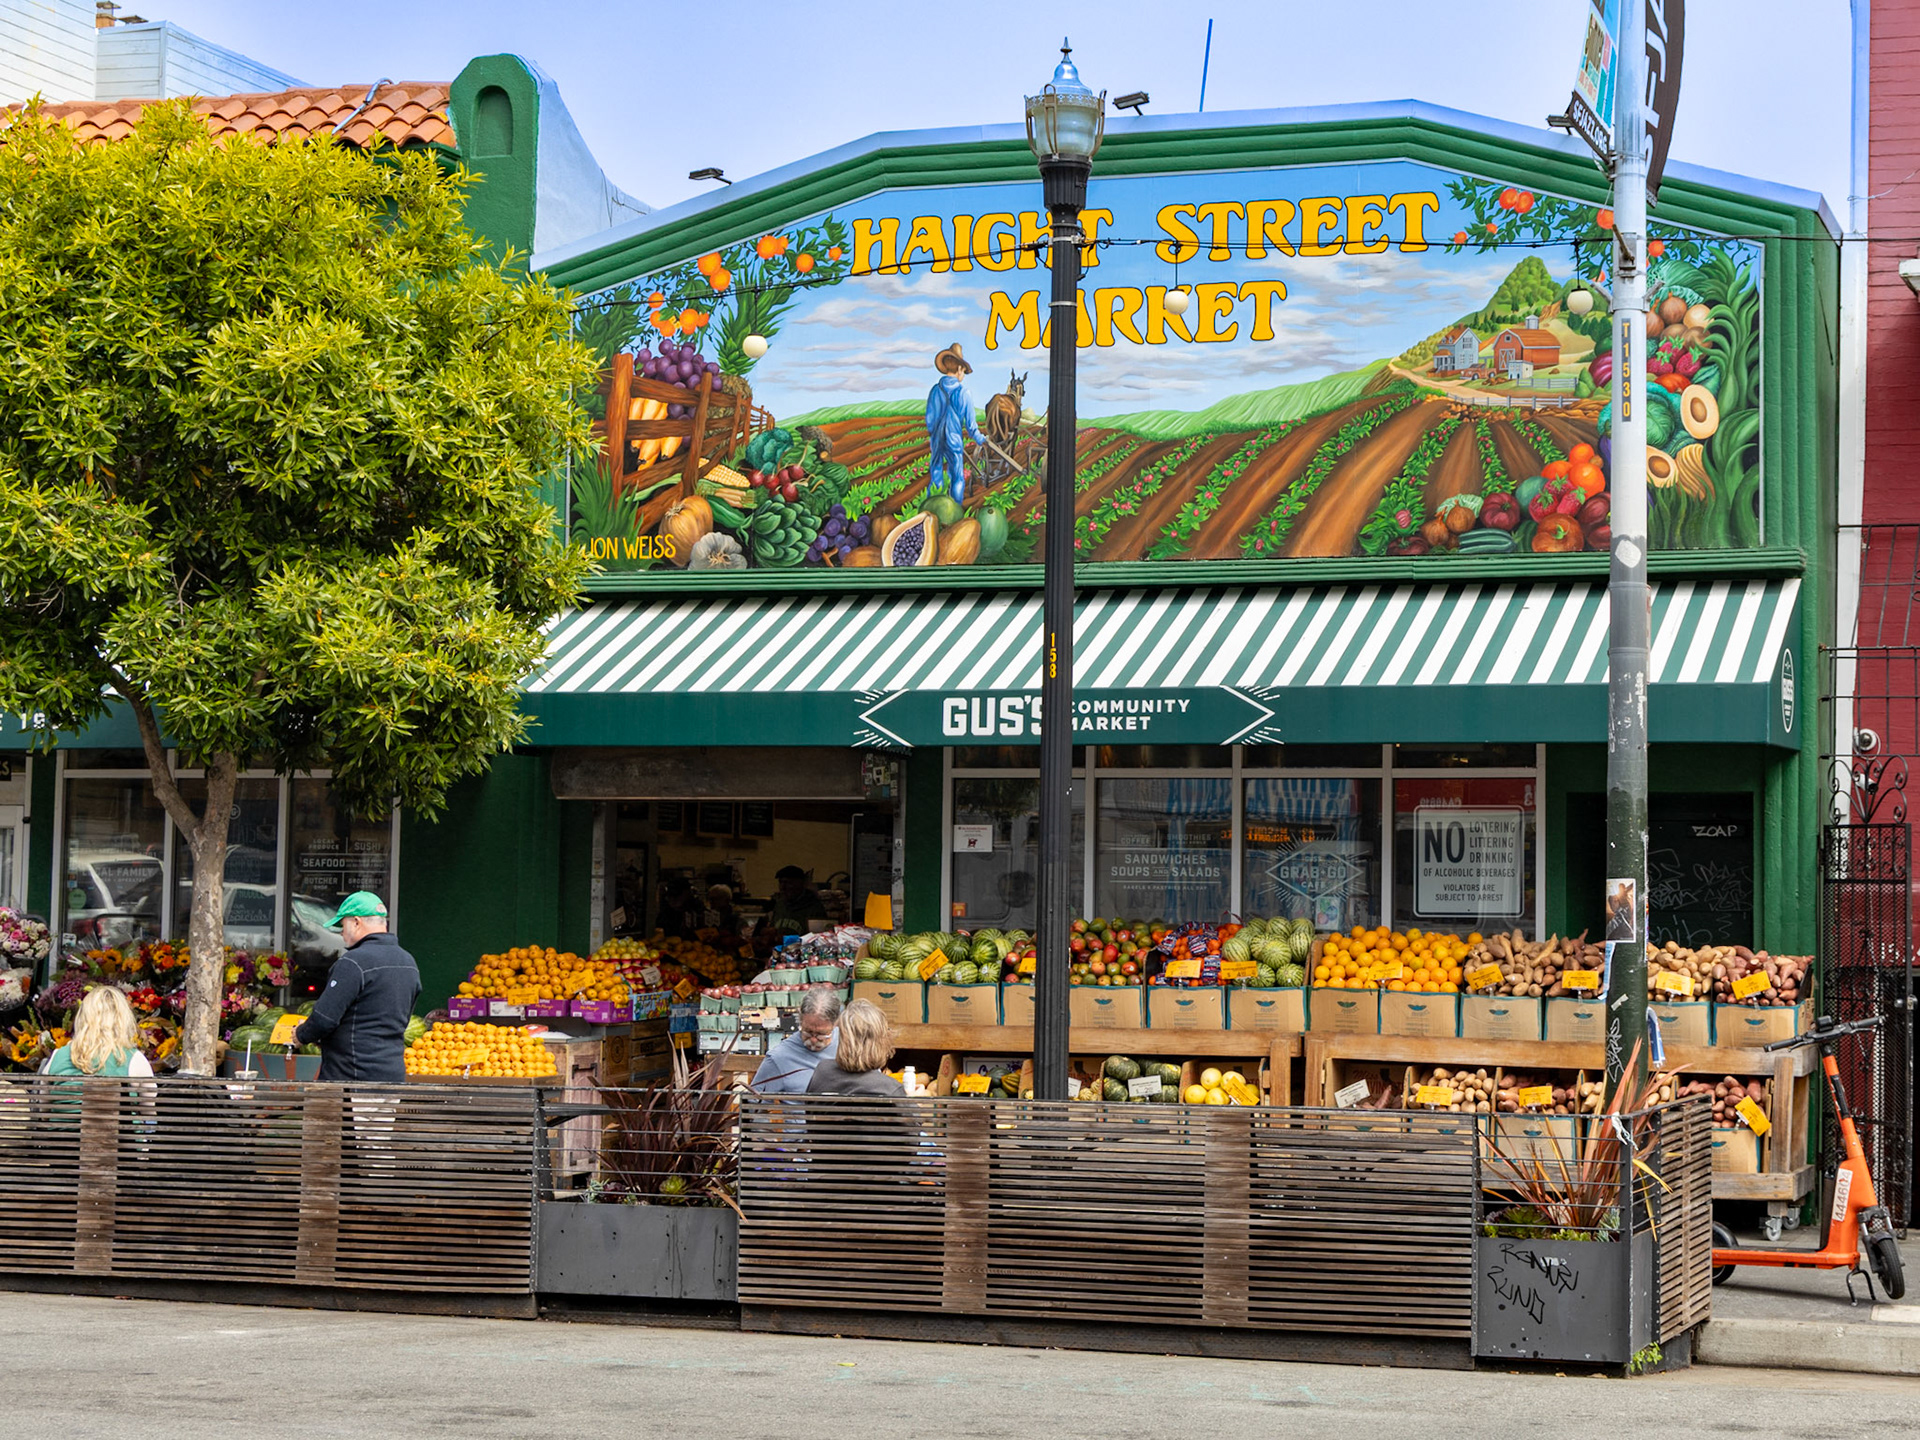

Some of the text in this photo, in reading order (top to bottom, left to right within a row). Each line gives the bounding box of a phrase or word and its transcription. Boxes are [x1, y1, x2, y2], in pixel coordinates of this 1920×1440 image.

[851, 191, 1440, 276] HAIGHT STREET
[1622, 322, 1631, 417] T1530
[581, 533, 677, 560] JON WEISS
[1071, 699, 1191, 714] OMMUNITY
[1120, 837, 1151, 845] COFFEE
[1167, 833, 1212, 841] SMOOTHIES
[1424, 821, 1516, 864] NO LOITERING
[1469, 837, 1514, 848] LITTERING
[354, 842, 381, 851] SUSHI
[302, 858, 346, 868] SEAFOOD
[1124, 854, 1207, 865] SANDWICHES
[1469, 852, 1513, 864] DRINKING
[117, 867, 154, 877] FAMILY
[1111, 866, 1150, 877] SOUPS
[1171, 867, 1221, 877] SALADS
[1423, 868, 1516, 878] OF ALCOHOLIC BEVERAGES
[304, 877, 338, 885] BUTCHER
[1443, 884, 1496, 892] VIOLATORS ARE
[1435, 893, 1504, 902] SUBJECT TO ARREST
